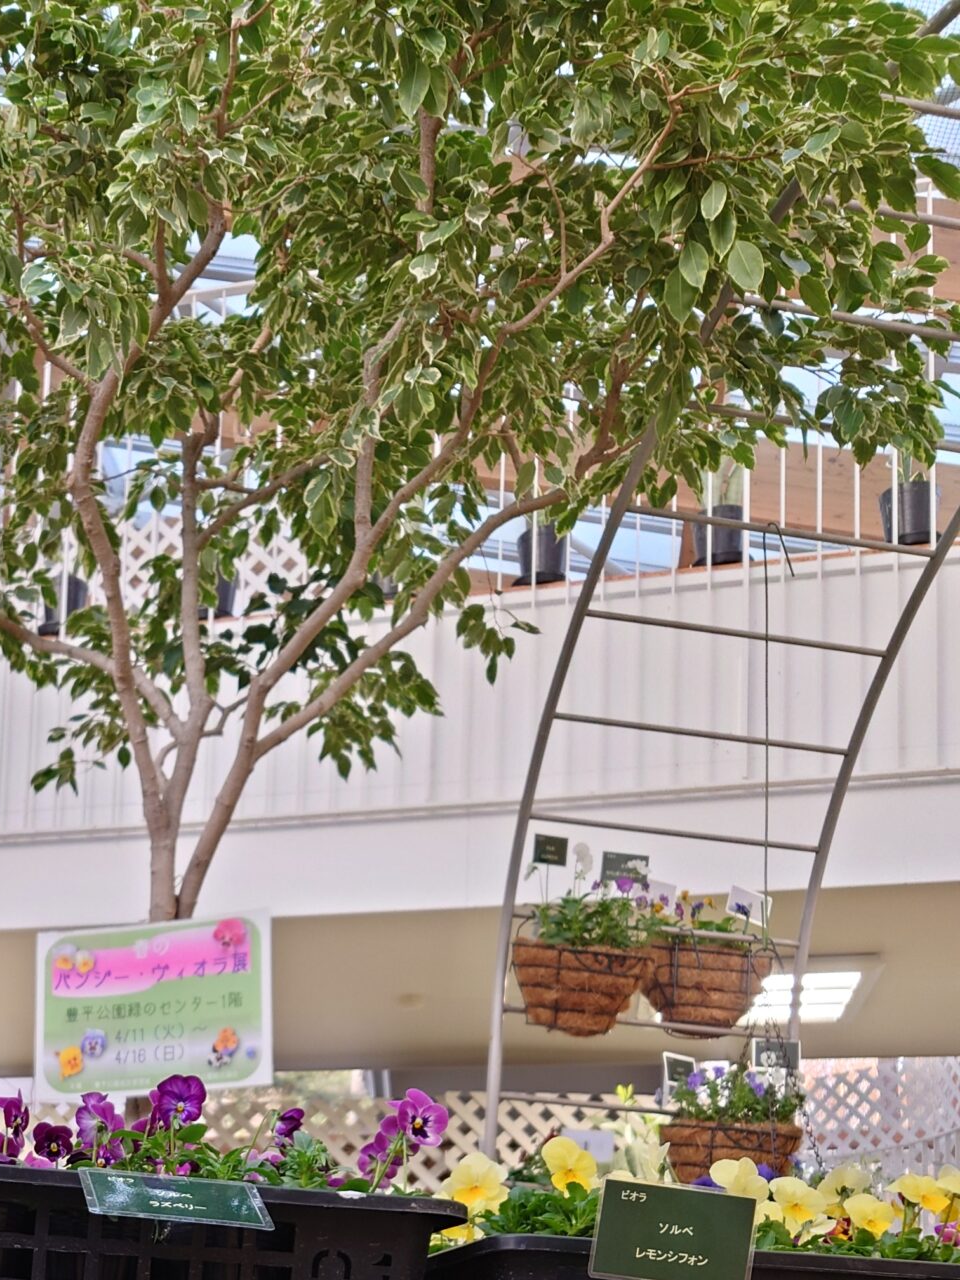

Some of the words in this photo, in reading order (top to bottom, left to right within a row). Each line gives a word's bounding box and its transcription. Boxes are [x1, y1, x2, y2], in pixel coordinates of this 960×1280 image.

[54, 951, 249, 990] パンジー・ヴィオラ展
[620, 1189, 647, 1203] ビオラ
[658, 1222, 694, 1236] ソルベ
[635, 1247, 709, 1267] レモンシフォン
